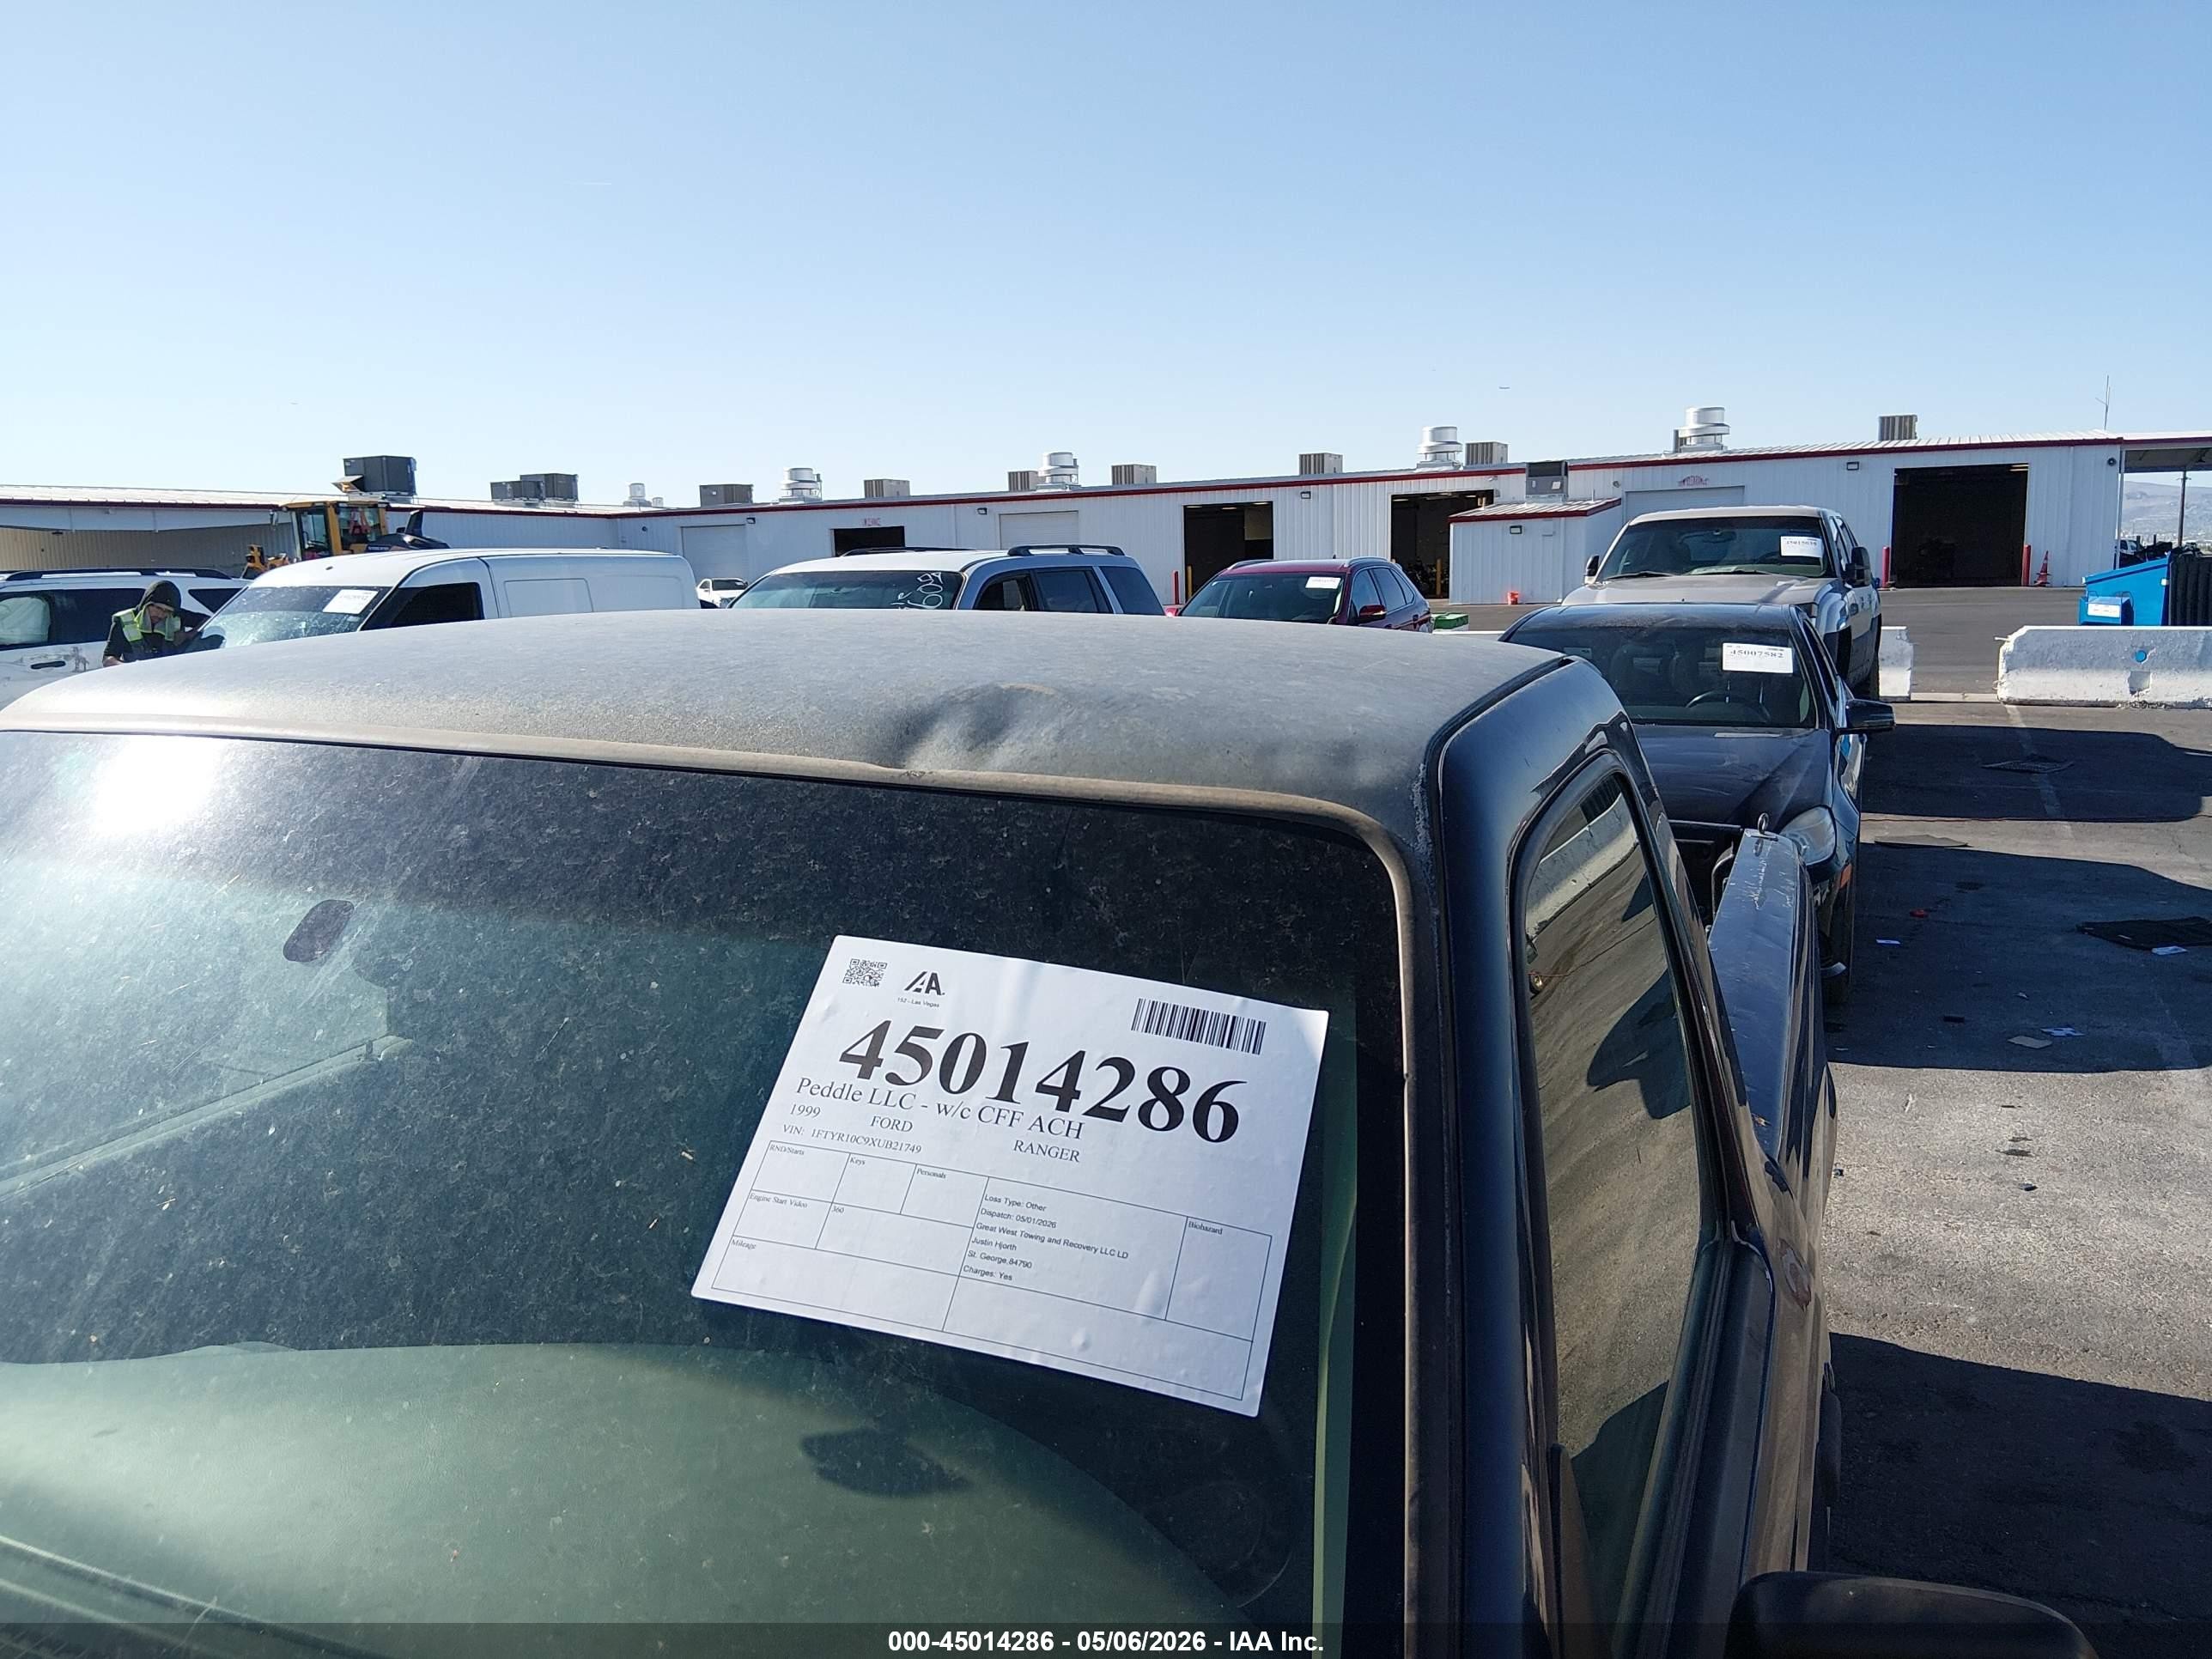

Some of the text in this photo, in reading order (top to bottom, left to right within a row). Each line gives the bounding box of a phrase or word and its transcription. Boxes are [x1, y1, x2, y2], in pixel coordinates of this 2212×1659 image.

[839, 1020, 1248, 1143] 45014286
[797, 1077, 862, 1102] Peddle
[867, 1088, 916, 1110] LLC
[936, 1101, 971, 1120] w/c
[978, 1105, 1024, 1127] CFF
[1027, 1115, 1085, 1139] ACH
[783, 1124, 921, 1154] VIN: 1FTYR10C9XUB21749
[790, 1103, 1080, 1163] 1999 FORD RANGER
[850, 1157, 866, 1166] Keys
[916, 1168, 946, 1179] Personals
[750, 1193, 807, 1208] Engine Start Video
[985, 1194, 1047, 1212] Loss Type: Other
[981, 1208, 1057, 1229] Dispatch: 05/01/2026
[1188, 1221, 1223, 1235] Biohazard
[732, 1239, 756, 1249] Mileage
[972, 1237, 1018, 1251] Justin Hjorth
[976, 1222, 1129, 1259] Great West Towing and Recovery LLC LD
[963, 1265, 1012, 1280] Charges: Yes
